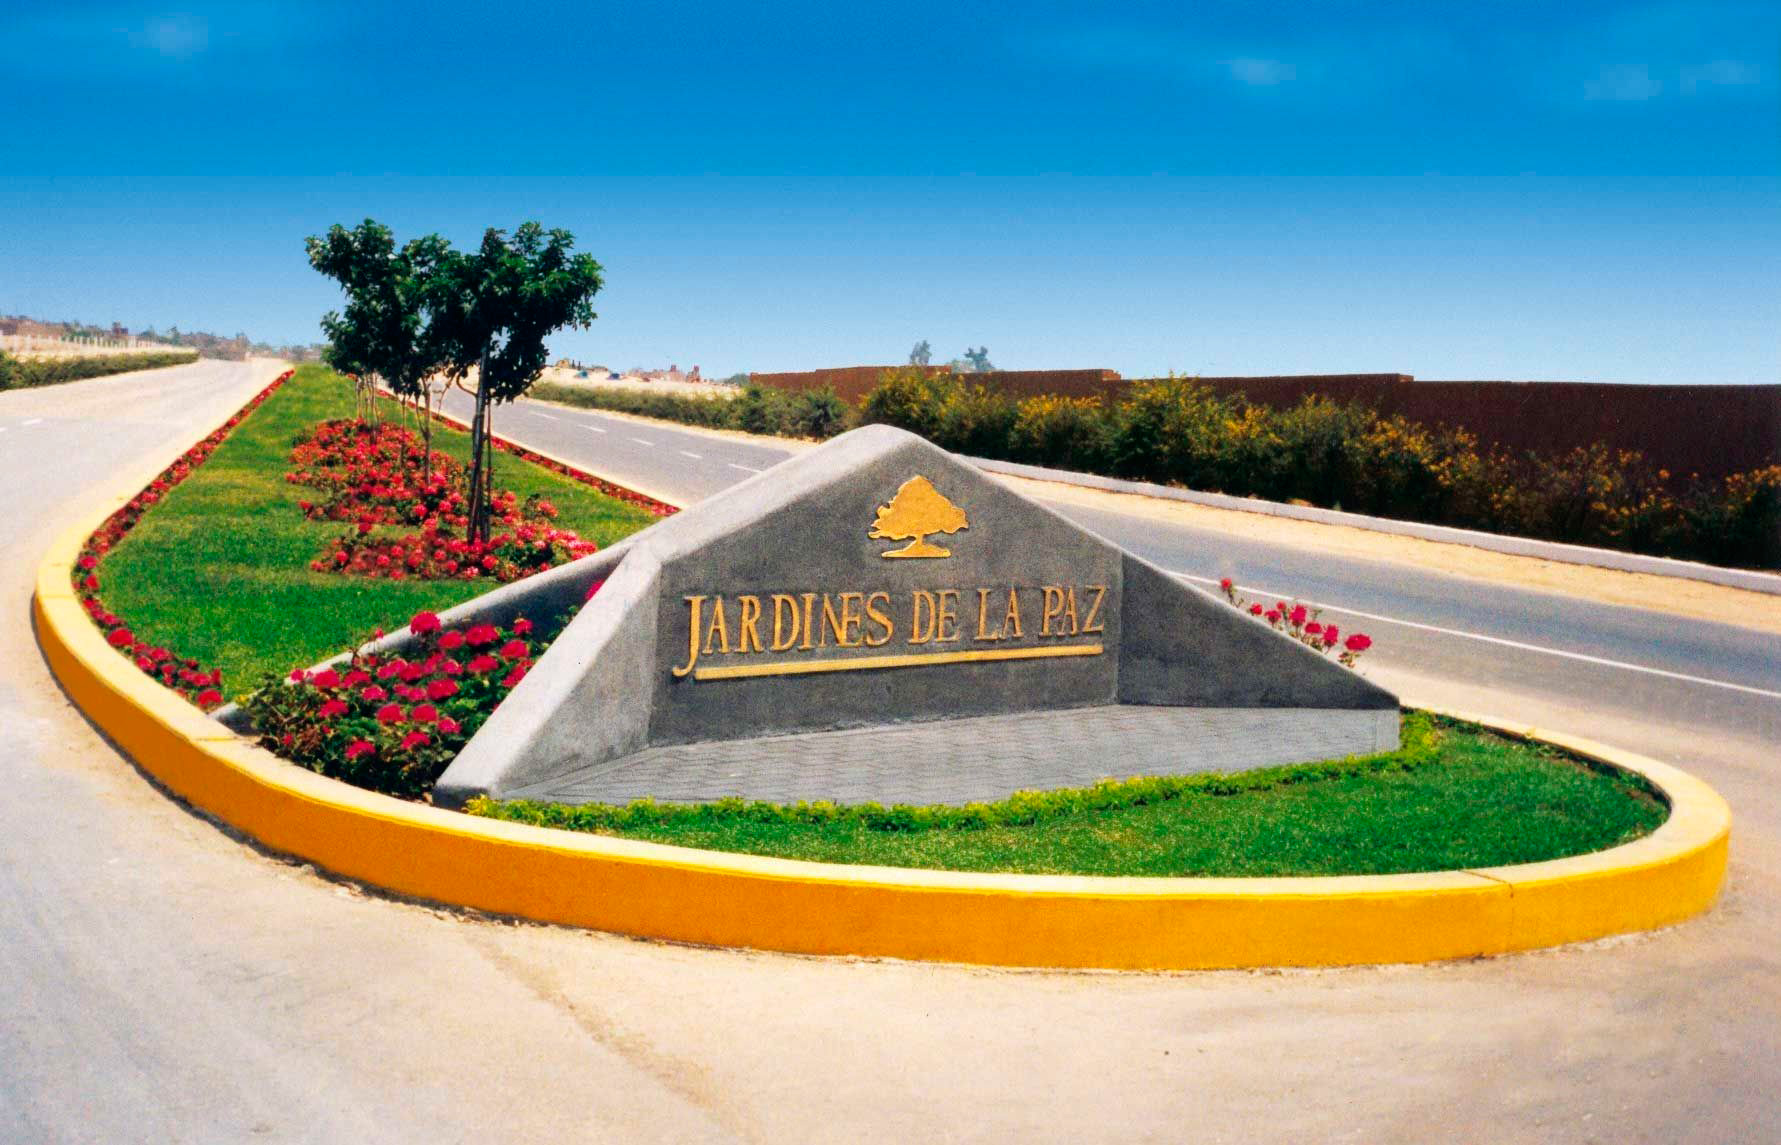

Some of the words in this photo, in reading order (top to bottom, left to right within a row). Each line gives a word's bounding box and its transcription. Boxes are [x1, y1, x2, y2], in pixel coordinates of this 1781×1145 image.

[672, 591, 894, 677] JARDINES
[908, 588, 961, 645] DE
[975, 587, 1025, 641] LA
[1038, 584, 1107, 637] PAZ
